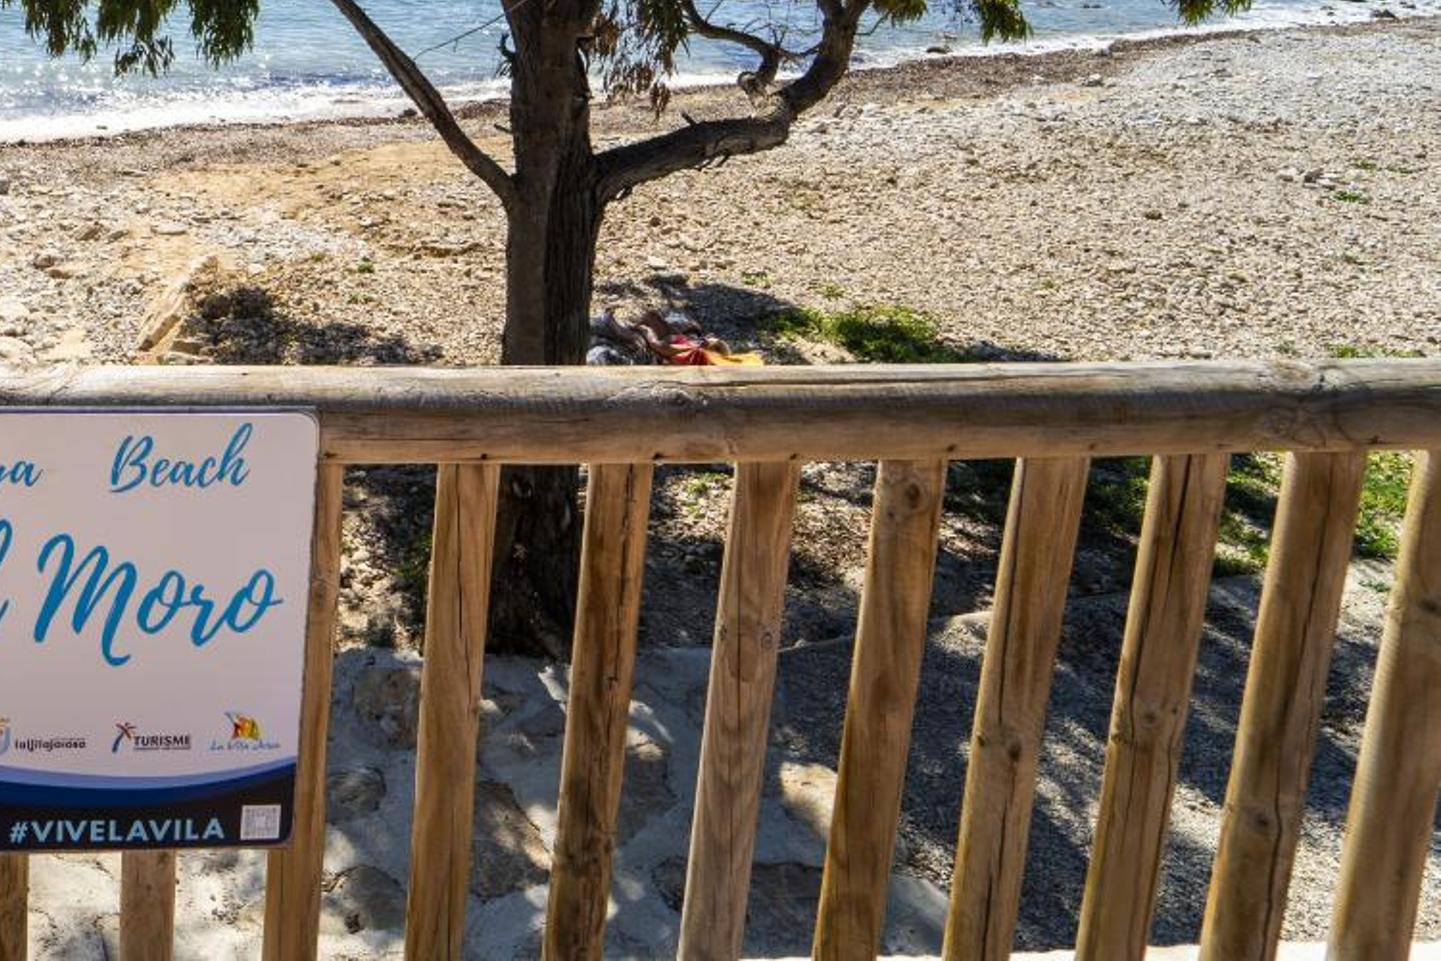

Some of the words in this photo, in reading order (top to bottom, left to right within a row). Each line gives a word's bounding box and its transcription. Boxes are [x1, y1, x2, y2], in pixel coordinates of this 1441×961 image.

[109, 422, 251, 494] Beach
[33, 532, 284, 667] Moro
[134, 735, 191, 747] TURISME
[10, 818, 225, 843] #VIVELAVILA
